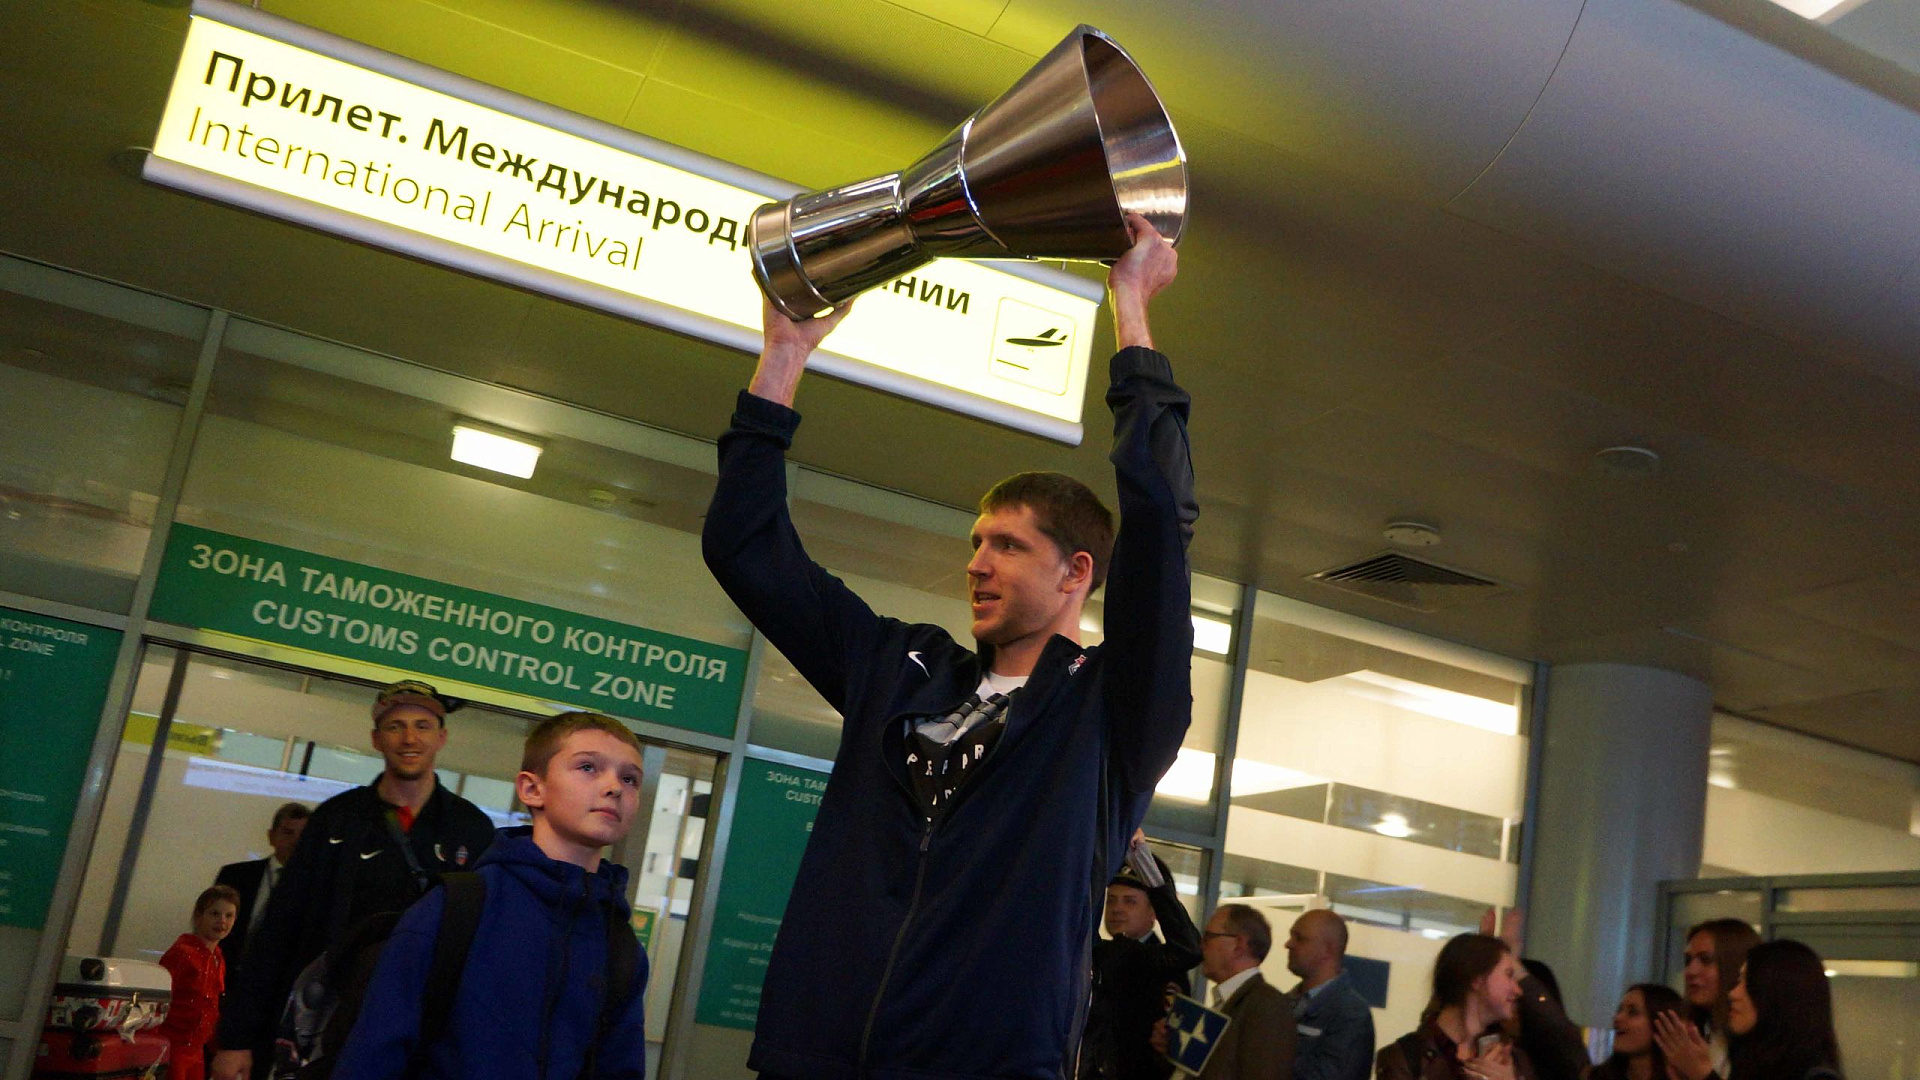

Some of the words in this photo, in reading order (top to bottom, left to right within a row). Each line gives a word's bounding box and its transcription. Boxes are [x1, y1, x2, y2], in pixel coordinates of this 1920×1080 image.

[187, 106, 492, 226] International
[503, 203, 644, 271] Arrival
[203, 51, 408, 144] Прилет.
[882, 275, 971, 315] нии
[188, 543, 287, 588] ЗОНА
[300, 567, 556, 643] ТАМОЖЕННОГО
[562, 628, 728, 683] КОНТРОЛЯ
[252, 599, 420, 655] CUSTOMS
[428, 636, 581, 691] CONTROL
[590, 671, 677, 711] ZONE
